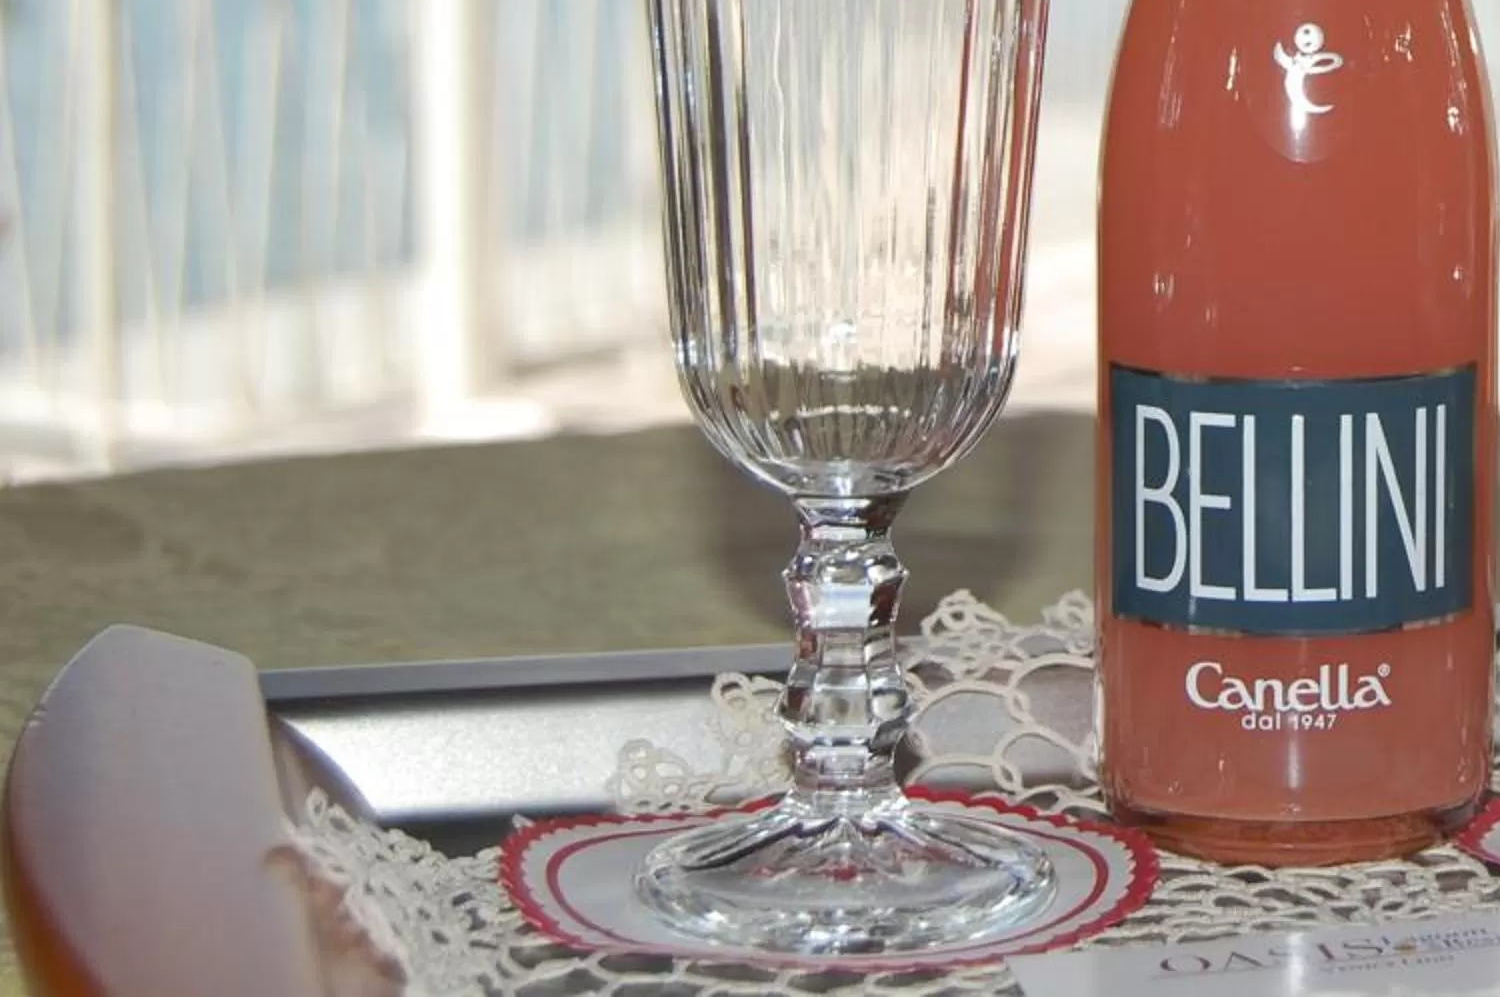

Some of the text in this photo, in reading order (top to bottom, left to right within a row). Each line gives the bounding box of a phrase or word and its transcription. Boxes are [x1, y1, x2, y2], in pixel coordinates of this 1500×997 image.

[1135, 403, 1446, 602] BELLINI
[1240, 713, 1337, 731] dal 1947
